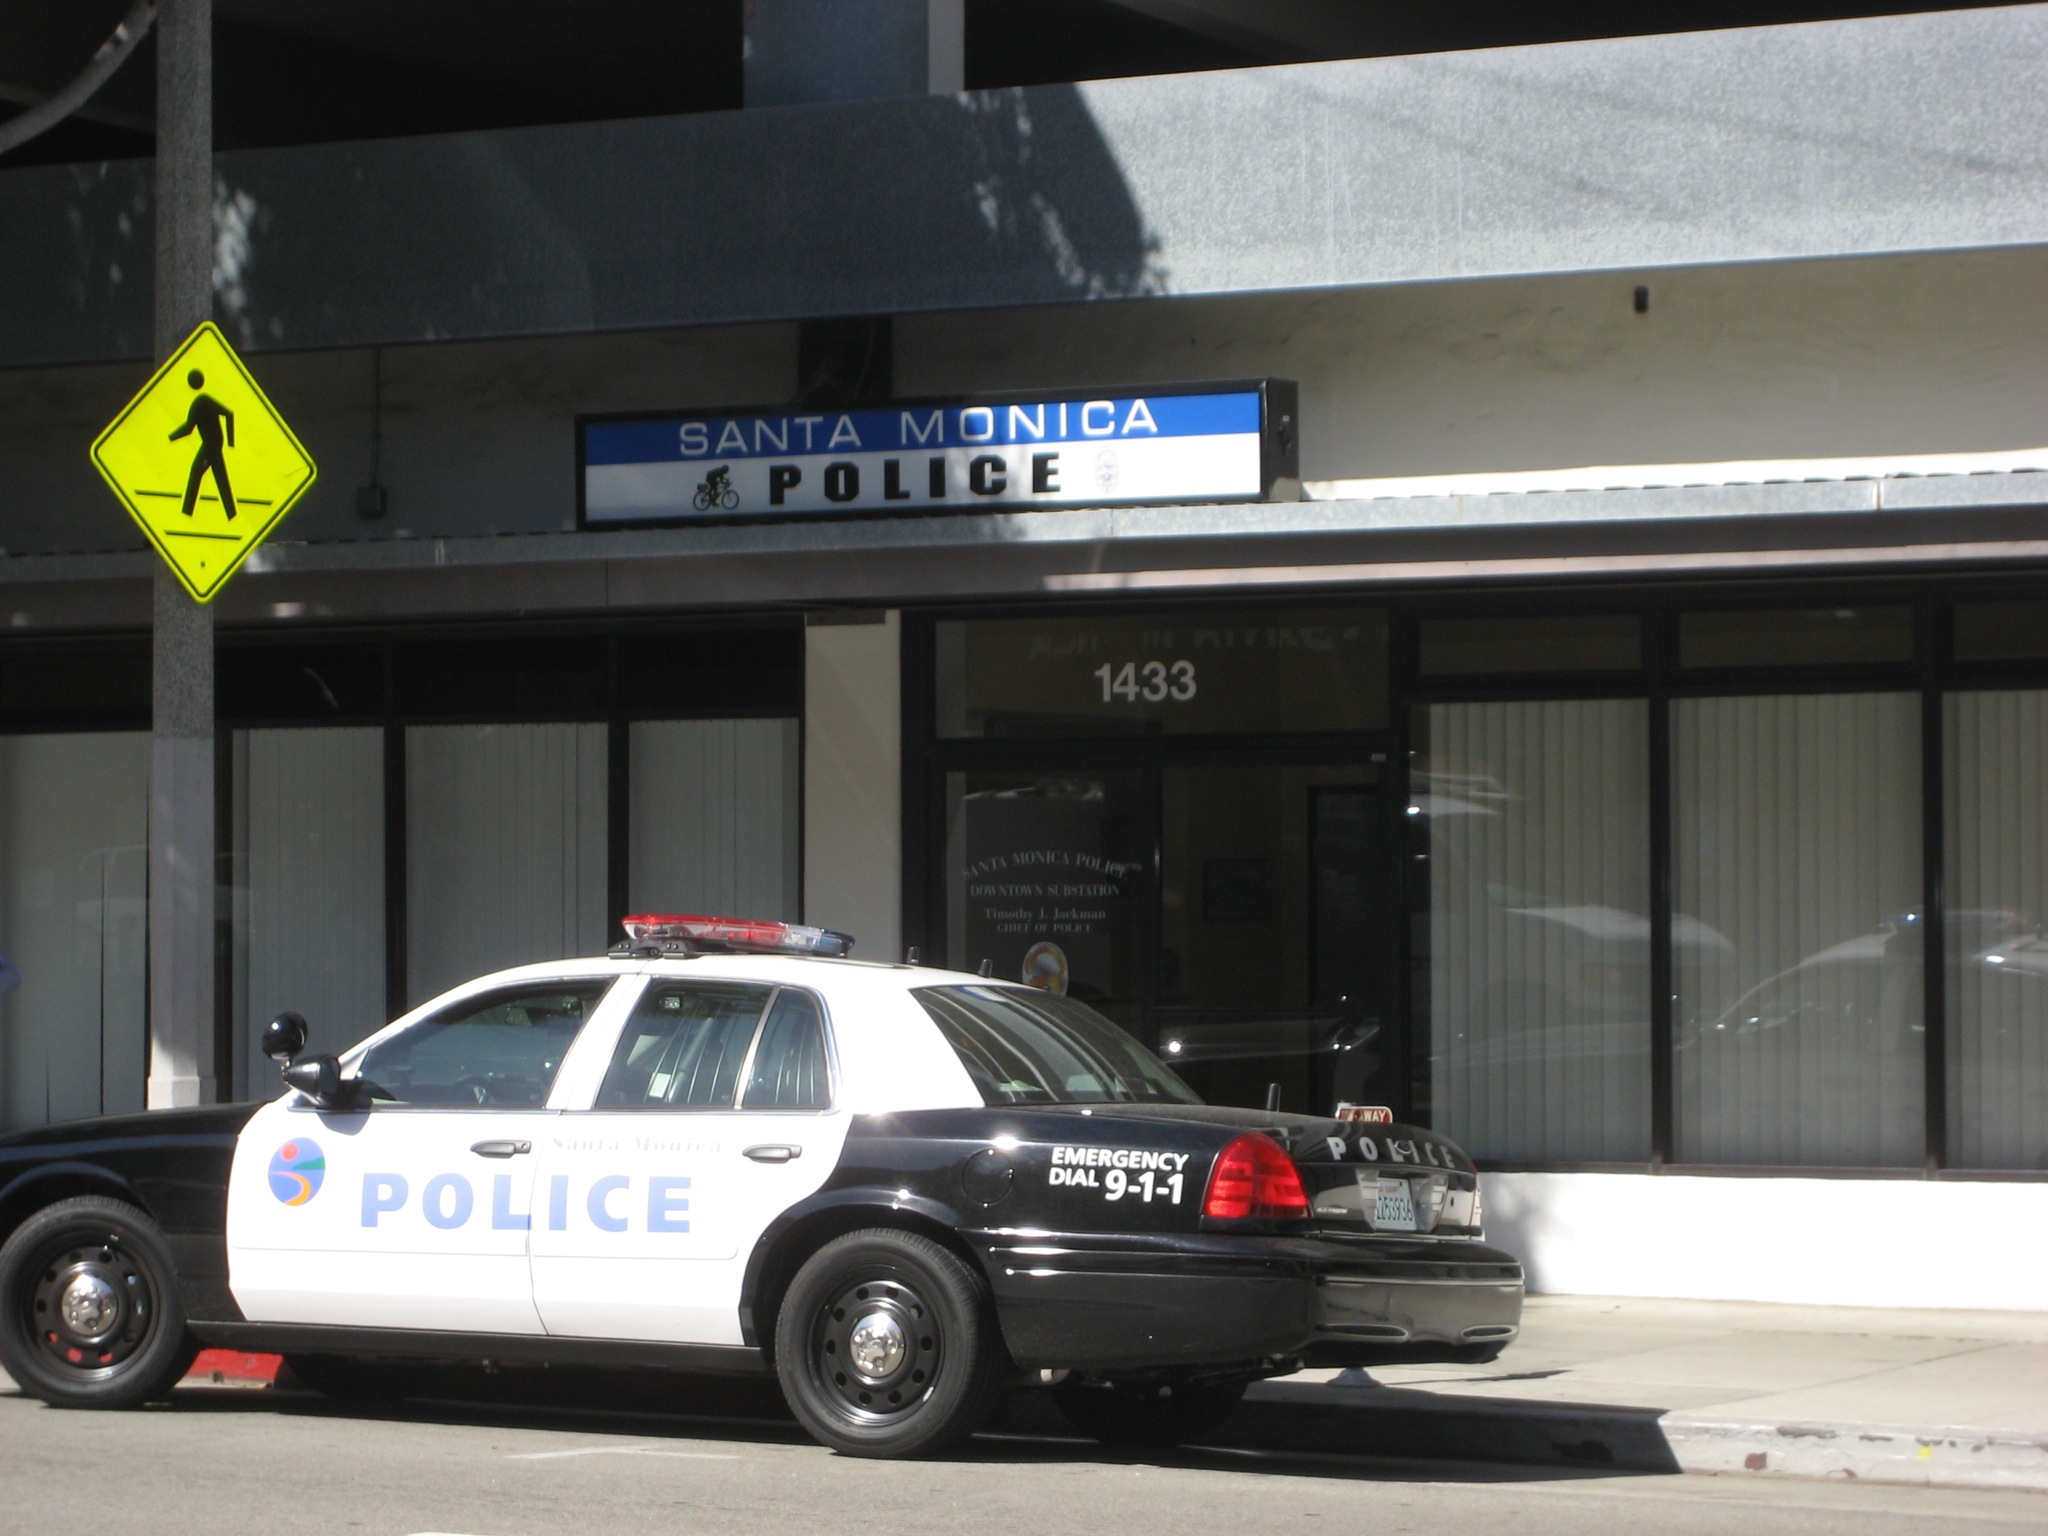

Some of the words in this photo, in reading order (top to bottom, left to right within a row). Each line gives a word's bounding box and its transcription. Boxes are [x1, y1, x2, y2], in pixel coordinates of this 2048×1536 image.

[680, 414, 862, 455] SANTA
[900, 399, 1158, 445] MONICA
[769, 452, 1061, 505] POLICE
[1095, 659, 1197, 702] 1433
[962, 856, 1008, 878] SANTA
[1013, 850, 1070, 866] MONICA
[1076, 852, 1127, 880] POLICE
[970, 884, 1043, 897] DOWNTOWN
[1047, 884, 1120, 897] SUBSTATION
[984, 908, 1033, 922] Timothy
[1053, 908, 1107, 920] Jackman
[1035, 923, 1049, 933] OF
[553, 1136, 620, 1152] Santa
[634, 1136, 722, 1153] Monica
[1051, 1147, 1189, 1171] EMERGENCY
[1326, 1136, 1457, 1169] POLICE
[1049, 1167, 1100, 1187] DIAL
[1105, 1169, 1184, 1205] 9-1-1
[361, 1172, 692, 1233] POLICE
